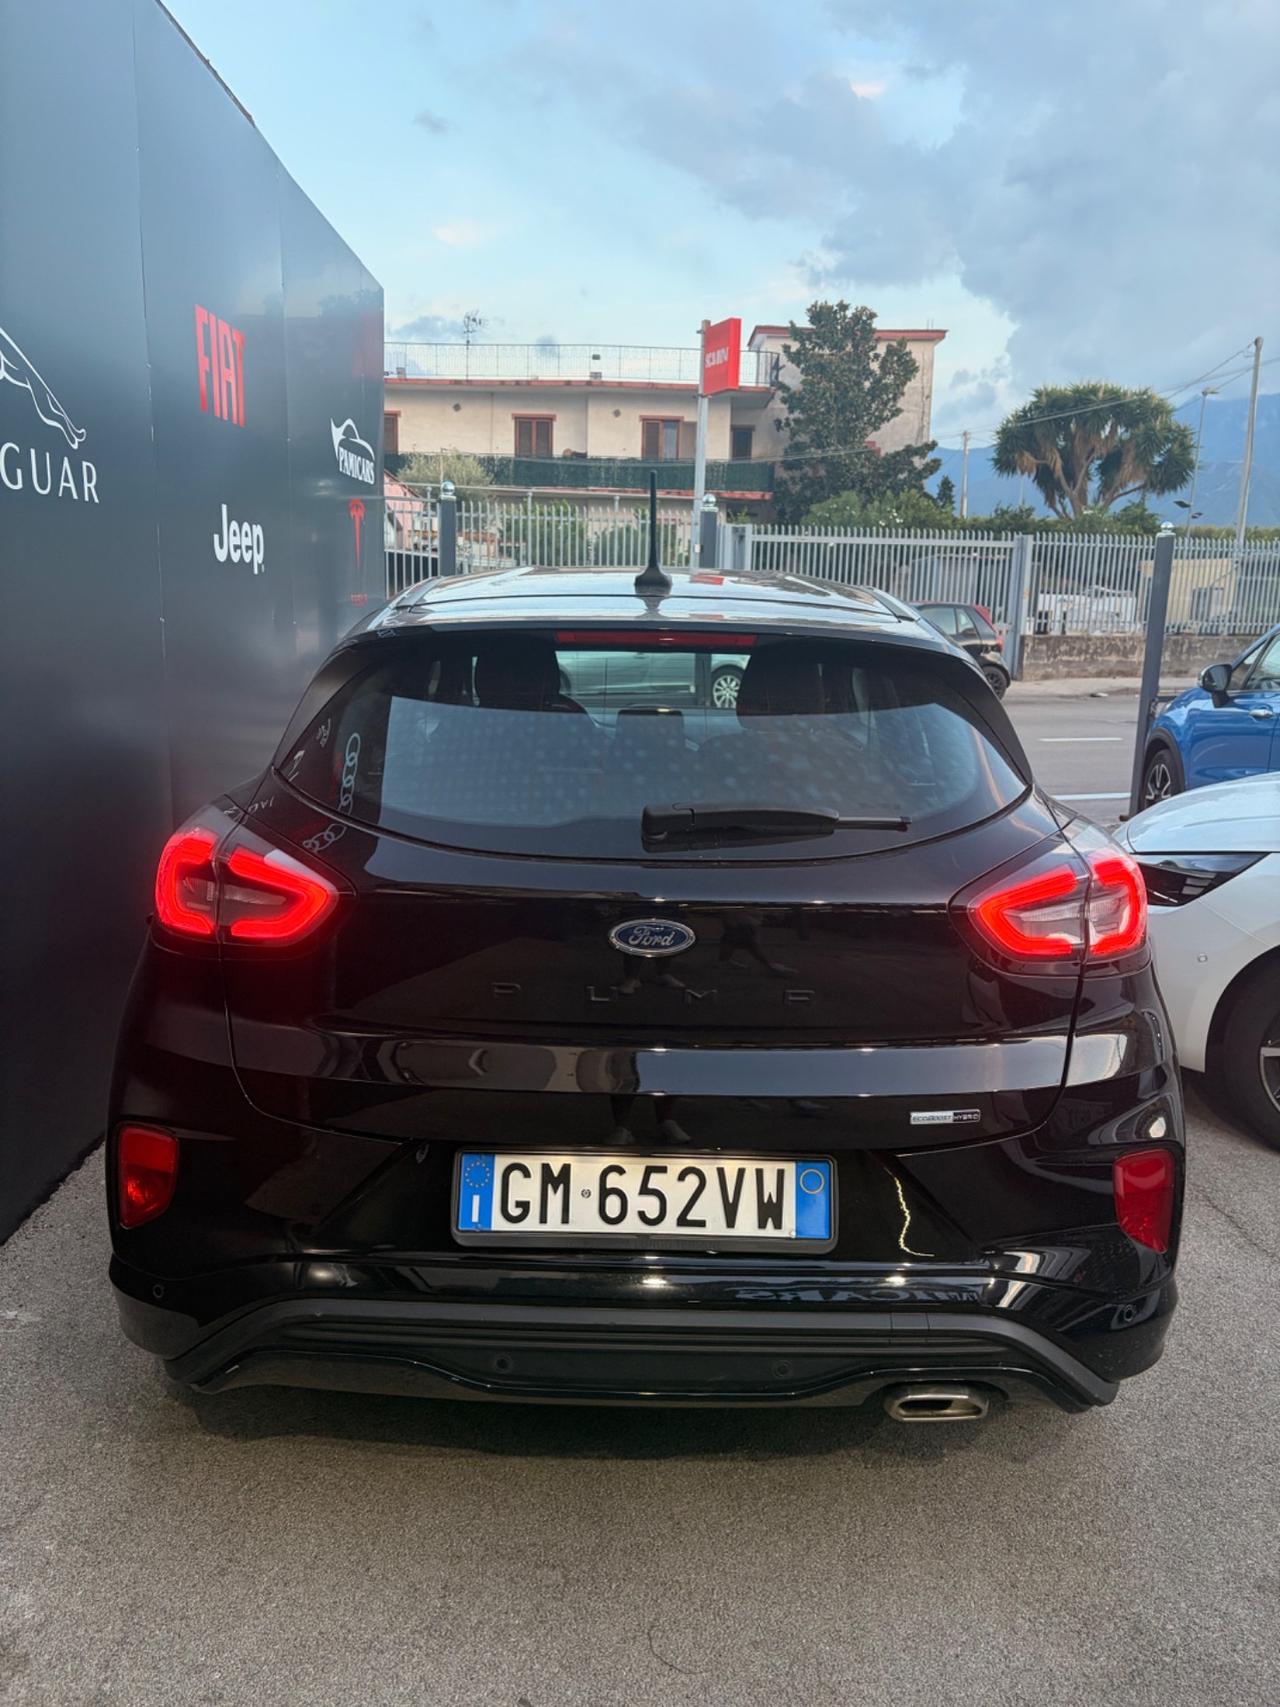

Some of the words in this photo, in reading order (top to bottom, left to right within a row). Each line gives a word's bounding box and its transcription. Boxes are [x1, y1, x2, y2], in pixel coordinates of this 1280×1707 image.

[194, 303, 245, 428] FIAT
[0, 442, 99, 503] GUAR
[213, 503, 264, 574] Jeep
[628, 925, 676, 946] Ford
[500, 1163, 572, 1225] GM
[598, 1164, 785, 1230] 652VW
